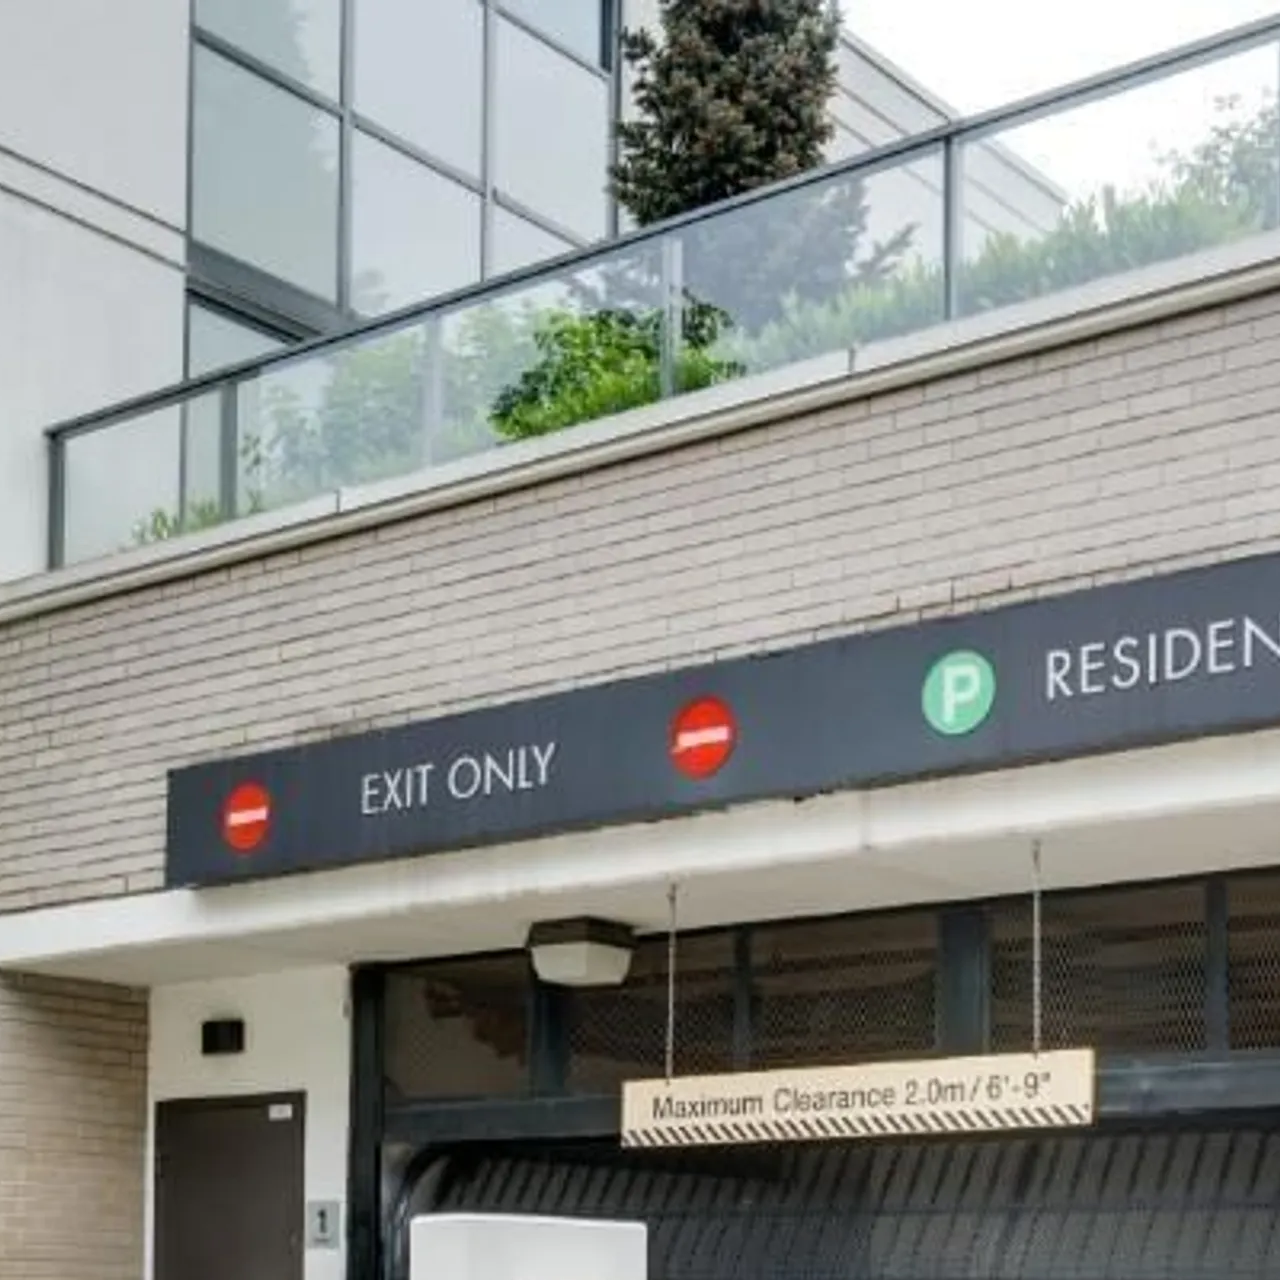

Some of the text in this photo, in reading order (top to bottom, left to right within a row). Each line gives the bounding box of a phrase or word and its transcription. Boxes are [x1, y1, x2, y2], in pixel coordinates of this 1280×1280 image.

[941, 661, 982, 724] P
[360, 741, 557, 815] EXIT ONLY
[652, 1095, 764, 1120] Maximum
[773, 1082, 896, 1113] Clearance
[905, 1077, 966, 1105] 2.0m
